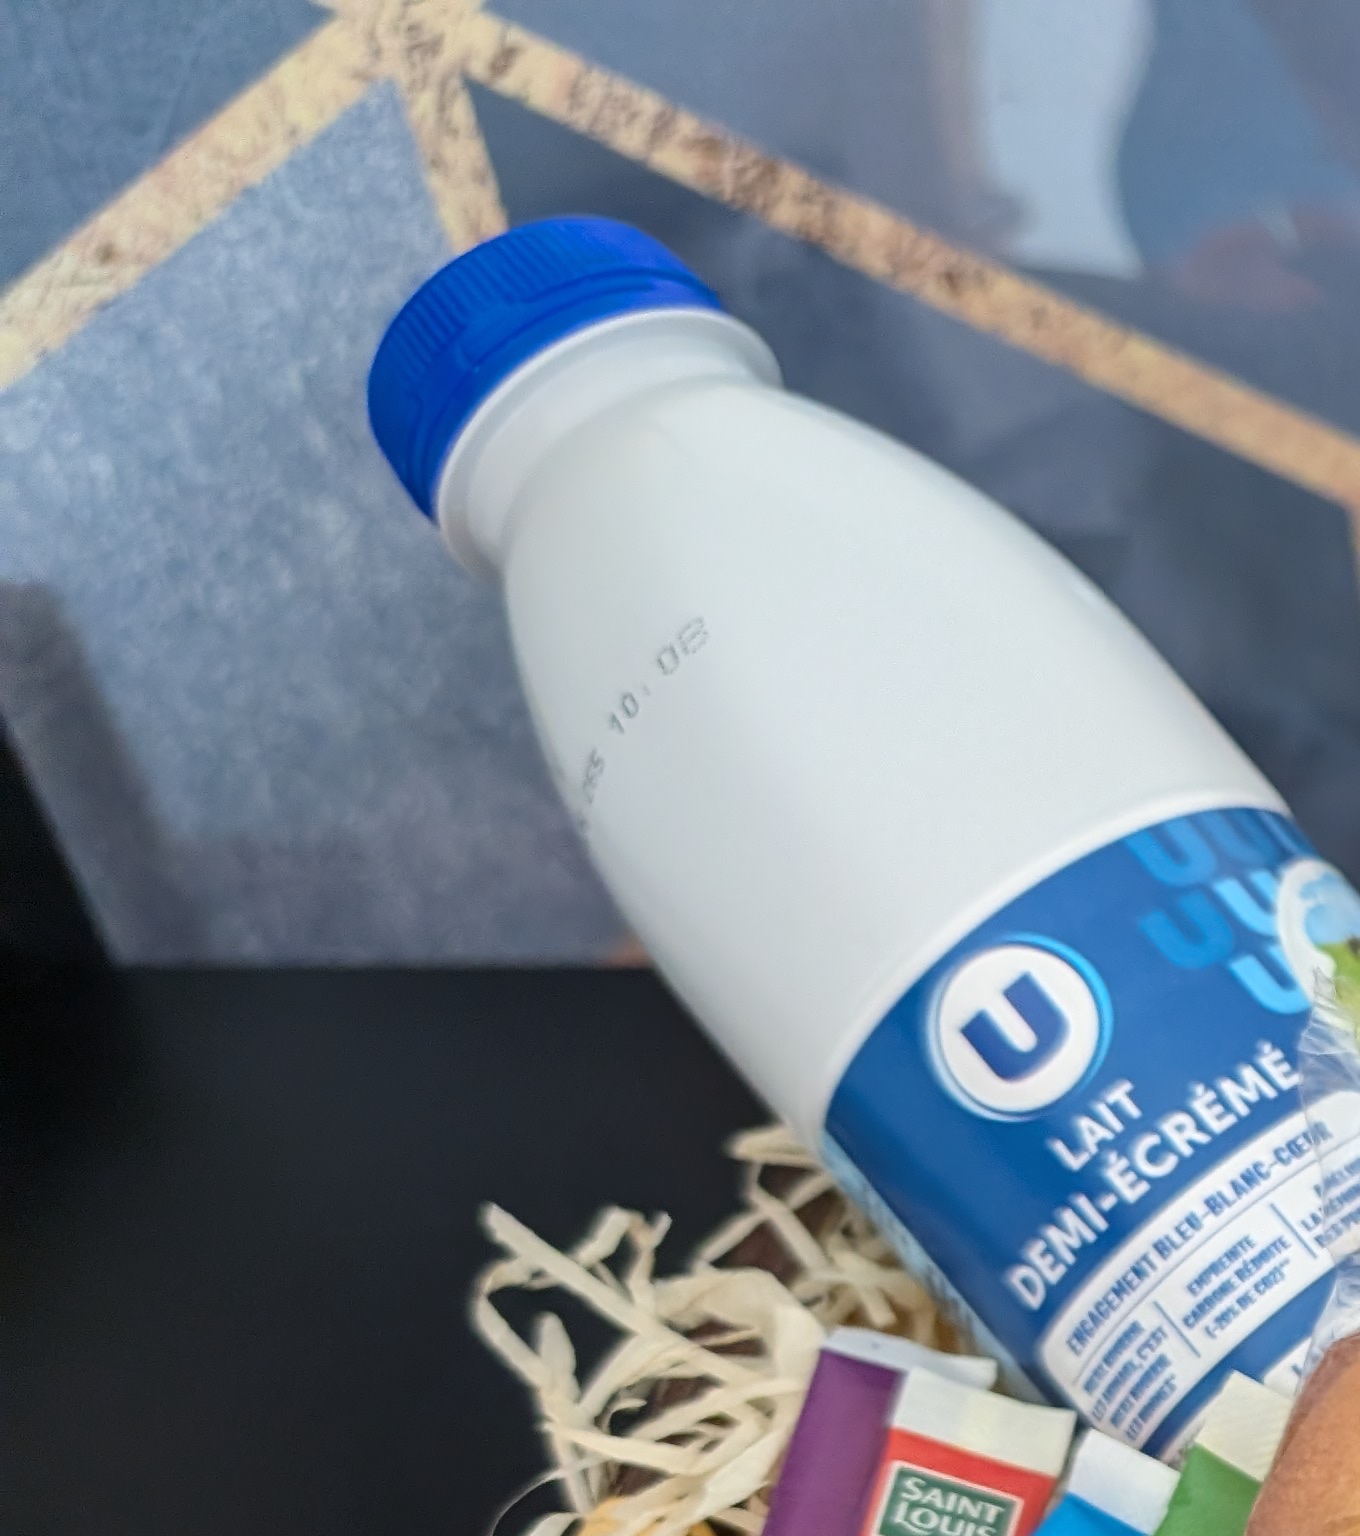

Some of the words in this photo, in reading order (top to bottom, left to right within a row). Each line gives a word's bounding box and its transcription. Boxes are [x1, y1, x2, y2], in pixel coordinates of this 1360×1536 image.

[959, 972, 1069, 1082] U
[1006, 1040, 1299, 1311] DEMI-ÉCRÉMÉ
[1048, 1078, 1143, 1172] LAIT
[1065, 1252, 1158, 1355] ENGAGEMENT
[902, 1477, 1004, 1523] SAINT
